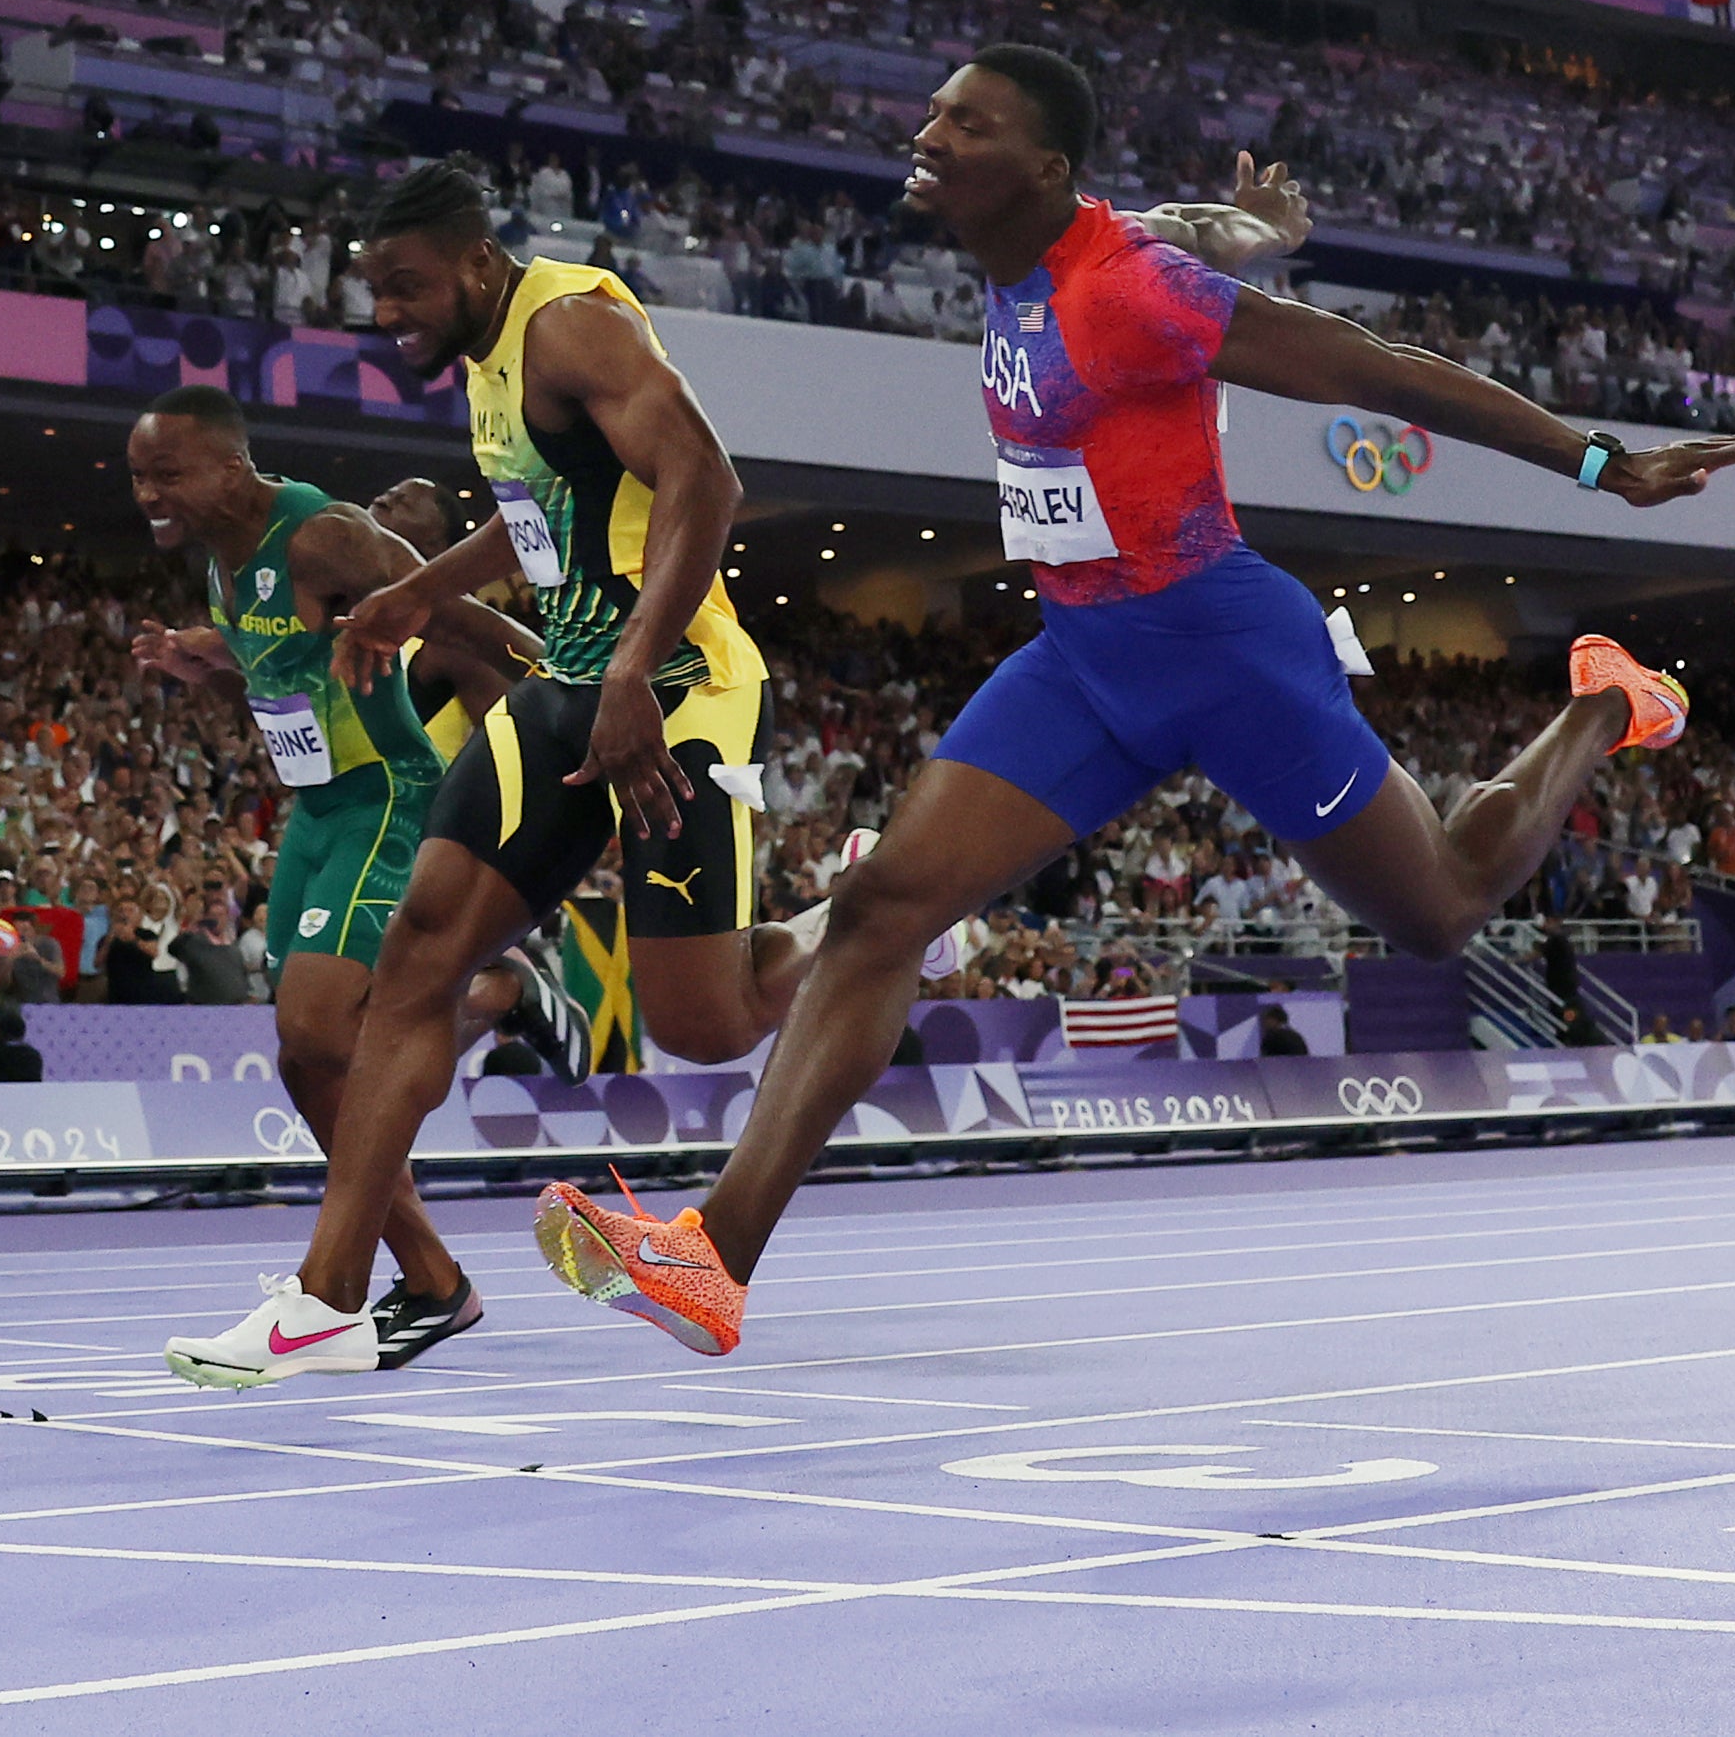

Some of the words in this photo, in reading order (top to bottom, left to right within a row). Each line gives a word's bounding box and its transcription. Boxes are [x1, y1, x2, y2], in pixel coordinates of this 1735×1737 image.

[981, 329, 1043, 417] USA
[1050, 1097, 1155, 1130] PARIS
[1163, 1094, 1256, 1126] 2024
[940, 1444, 1440, 1490] 3
